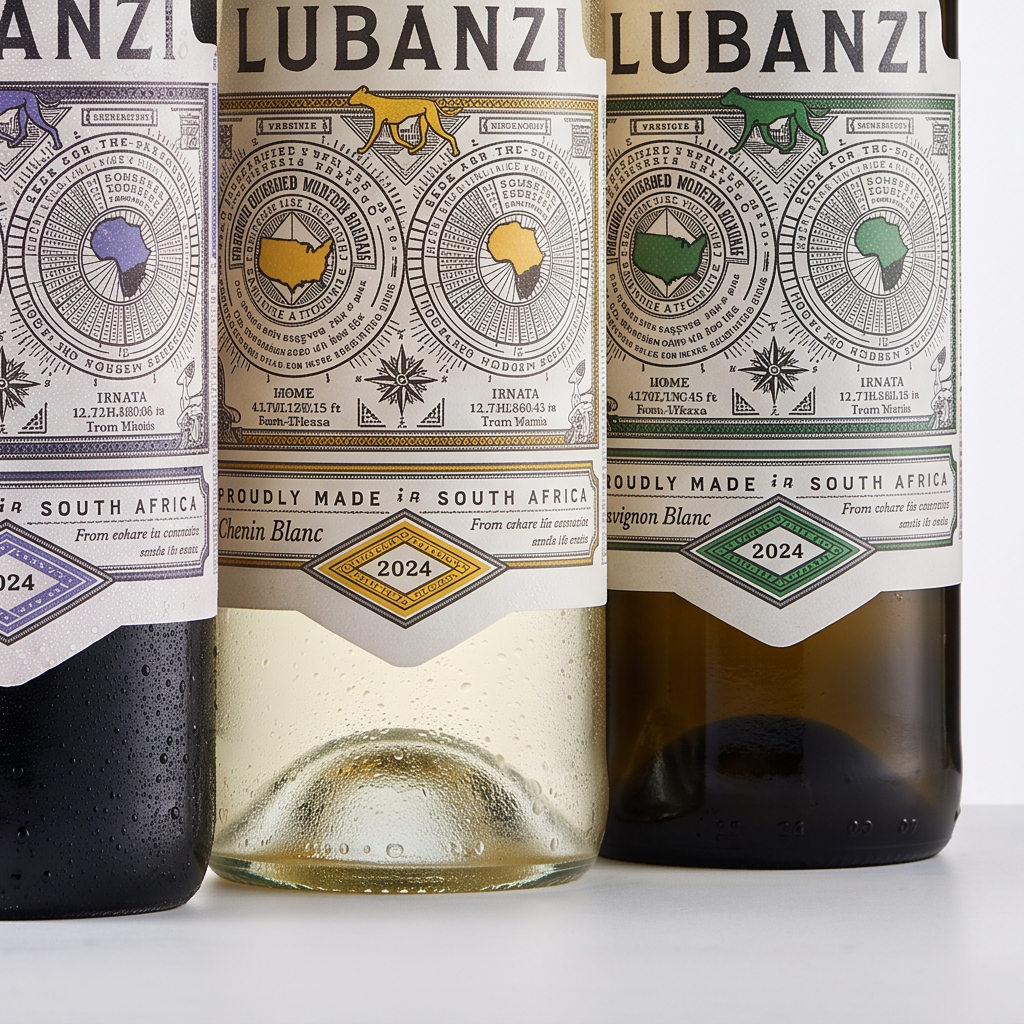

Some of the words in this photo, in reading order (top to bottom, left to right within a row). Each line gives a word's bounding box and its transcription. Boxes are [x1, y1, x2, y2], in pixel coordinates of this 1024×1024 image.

[237, 5, 566, 73] LUBANZI
[610, 10, 927, 75] LUBANZI
[96, 391, 148, 404] IRNATA
[491, 388, 540, 400] IRNATA
[330, 402, 342, 414] ft
[691, 477, 755, 491] MADE
[811, 476, 882, 491] SOUTH
[895, 473, 950, 489] AFRICA
[219, 488, 300, 505] PROUDLY
[315, 491, 380, 506] MADE
[438, 490, 514, 506] SOUTH
[528, 488, 586, 504] AFRICA
[41, 500, 120, 516] SOUTH
[135, 496, 196, 514] AFRICA
[840, 502, 872, 515] From
[469, 517, 503, 531] From
[662, 507, 711, 525] Blanc
[74, 528, 109, 542] From
[219, 517, 266, 541] Chenin
[270, 520, 323, 542] Blanc
[752, 543, 804, 559] 2024
[377, 560, 432, 577] 2024
